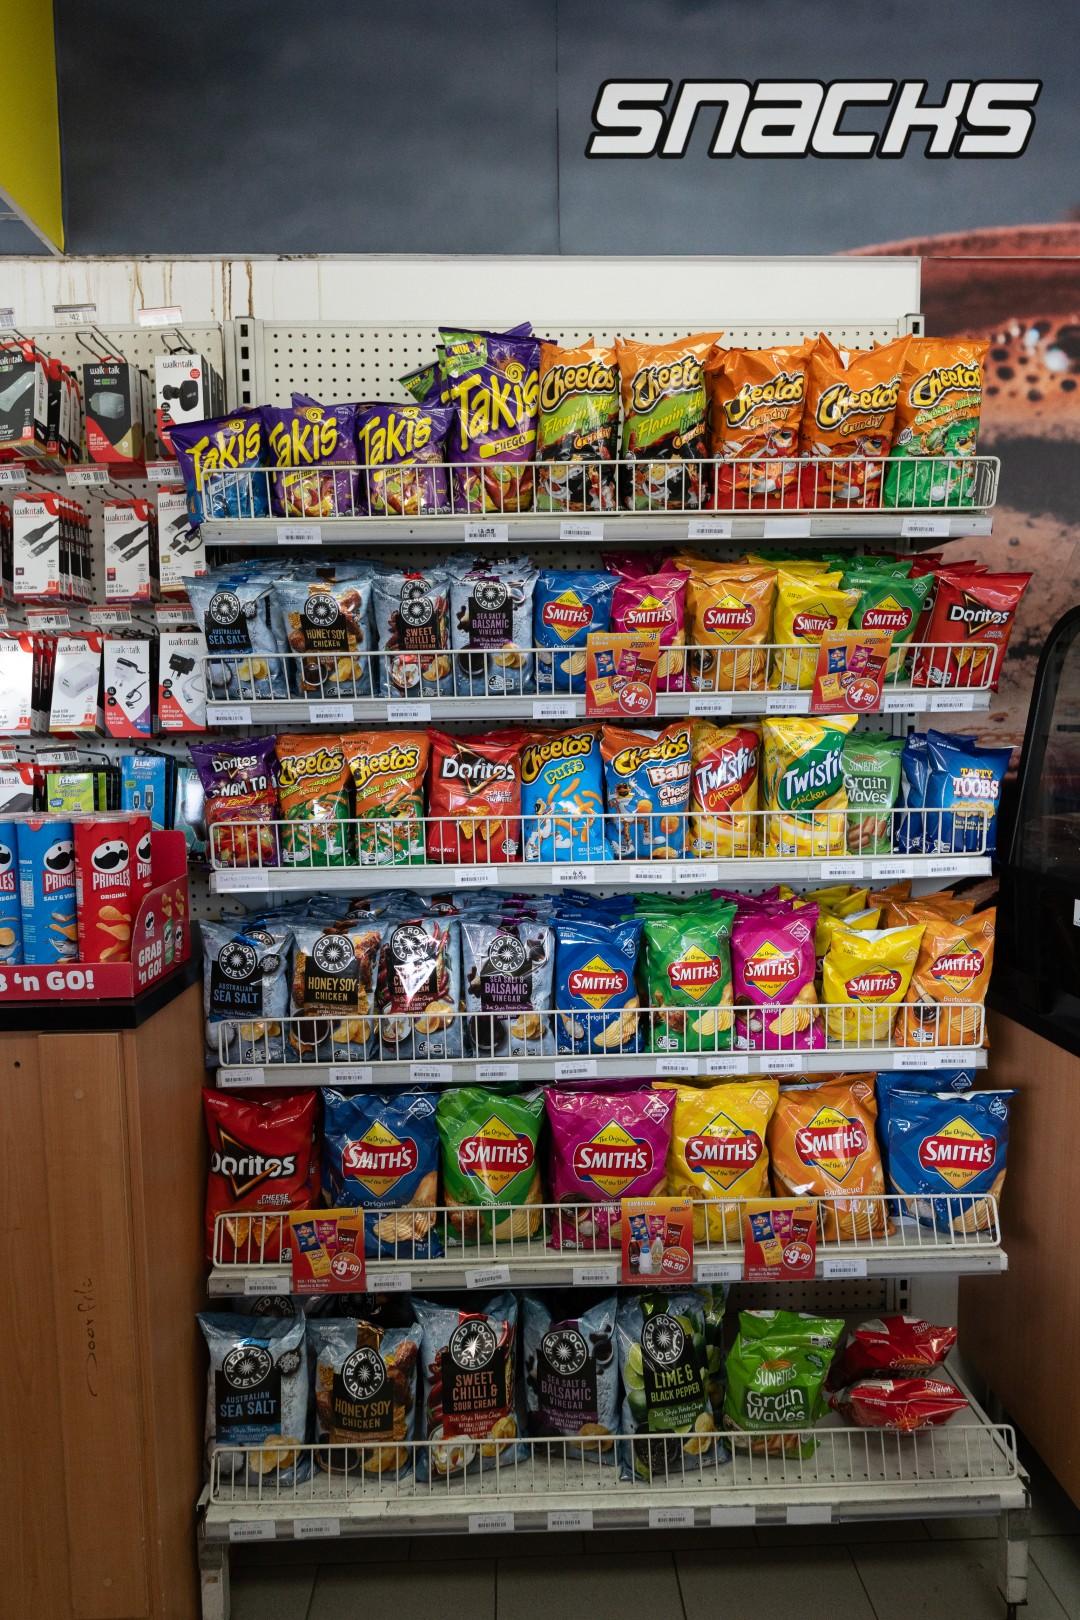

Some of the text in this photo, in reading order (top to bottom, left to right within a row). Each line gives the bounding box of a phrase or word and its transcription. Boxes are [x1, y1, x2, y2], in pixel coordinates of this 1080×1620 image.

[89, 366, 120, 375] walkntalk
[162, 359, 193, 368] walkntalk
[541, 360, 616, 412] Cheetos
[815, 378, 900, 430] Cheetos
[839, 415, 885, 436] Crunchy
[493, 434, 526, 454] FUEGO
[14, 507, 45, 516] walkntalk
[159, 499, 188, 508] walkntal
[105, 514, 135, 522] walkntalk
[477, 580, 506, 609] RED ROCK DELI
[307, 596, 339, 625] RED ROCK DELI
[545, 604, 589, 622] SMITH'S
[626, 607, 673, 624] SMITH'S
[705, 609, 753, 625] SMITH'S
[864, 611, 909, 626] SMITH'S
[950, 605, 1010, 624] Doritos
[405, 626, 433, 637] SWEET
[472, 619, 509, 629] BALSAMIC
[795, 617, 834, 631] SMITH'S
[168, 638, 199, 646] walkntalk
[209, 634, 248, 645] SEA SALT
[306, 629, 346, 639] HONEY SOY
[404, 636, 430, 644] CHILLI
[622, 690, 649, 707] $4.50
[848, 686, 875, 703] $4.50
[212, 754, 258, 773] Doritos
[521, 733, 594, 784] Cheetos
[612, 732, 690, 777] Cheetos
[279, 747, 346, 787] Cheetos
[349, 745, 420, 791] Cheetos
[442, 758, 516, 779] Doritos
[544, 758, 585, 785] Puffs
[960, 768, 993, 779] TASTY
[844, 774, 887, 790] Grain
[952, 778, 1000, 799] TOOBS
[708, 783, 741, 808] Cheese
[790, 790, 828, 810] Chicken
[846, 789, 888, 804] Waves
[92, 869, 130, 890] PRINGLES
[100, 892, 128, 900] ORIGINAL
[138, 940, 162, 969] GRAB
[316, 936, 352, 971] RED ROCK DELI
[492, 938, 524, 972] RED ROCK DELI
[147, 959, 162, 980] GO!
[671, 962, 719, 981] SMITH'S
[745, 960, 795, 977] SMITH'S
[932, 956, 982, 971] SMITH'S
[14, 969, 95, 992] 'n GO!
[219, 983, 253, 991] AUSTRALIAN
[308, 977, 358, 991] HONEY SOY
[484, 983, 528, 994] BALSAMIC
[571, 973, 624, 990] SMITH'S
[848, 975, 898, 991] SMITH'S
[213, 990, 259, 1004] SEA SALT
[315, 991, 348, 1001] CHICKEN
[824, 1118, 845, 1126] Original
[491, 1129, 511, 1138] Original
[598, 1135, 629, 1144] The Original
[800, 1129, 862, 1154] SMITH'S
[953, 1129, 975, 1139] Original
[345, 1145, 412, 1169] SMITH'S
[464, 1141, 528, 1164] SMITH'S
[579, 1147, 648, 1169] SMITH'S
[688, 1140, 757, 1161] SMITH'S
[924, 1140, 993, 1163] SMITH'S
[662, 1258, 684, 1271] $8.50
[784, 1250, 811, 1264] $9.00
[332, 1260, 360, 1275] $9.00
[454, 1322, 494, 1368] RED ROCK DELI
[646, 1317, 681, 1362] RED ROCK DELI
[546, 1332, 585, 1372] RED ROCK DELI
[226, 1349, 269, 1386] RED ROCK DELI
[345, 1352, 384, 1397] RED ROCK DELI
[654, 1363, 694, 1389] LIME &
[754, 1364, 797, 1387] SUNBITES
[455, 1371, 495, 1386] SWEET
[547, 1375, 560, 1386] SEA
[562, 1379, 580, 1388] SALT
[226, 1391, 270, 1403] AUSTRALIAN
[452, 1383, 498, 1401] CHILLI &
[541, 1379, 592, 1400] BALSAMIC
[650, 1381, 701, 1402] BLACK PEPPER
[334, 1398, 392, 1417] HONEY SOY
[453, 1399, 497, 1411] SOUR CREAM
[550, 1397, 584, 1409] VINEGAR
[747, 1388, 804, 1410] Grain
[220, 1400, 276, 1418] SEA SALT
[747, 1404, 806, 1423] Waves
[342, 1416, 381, 1427] CHICKEN
